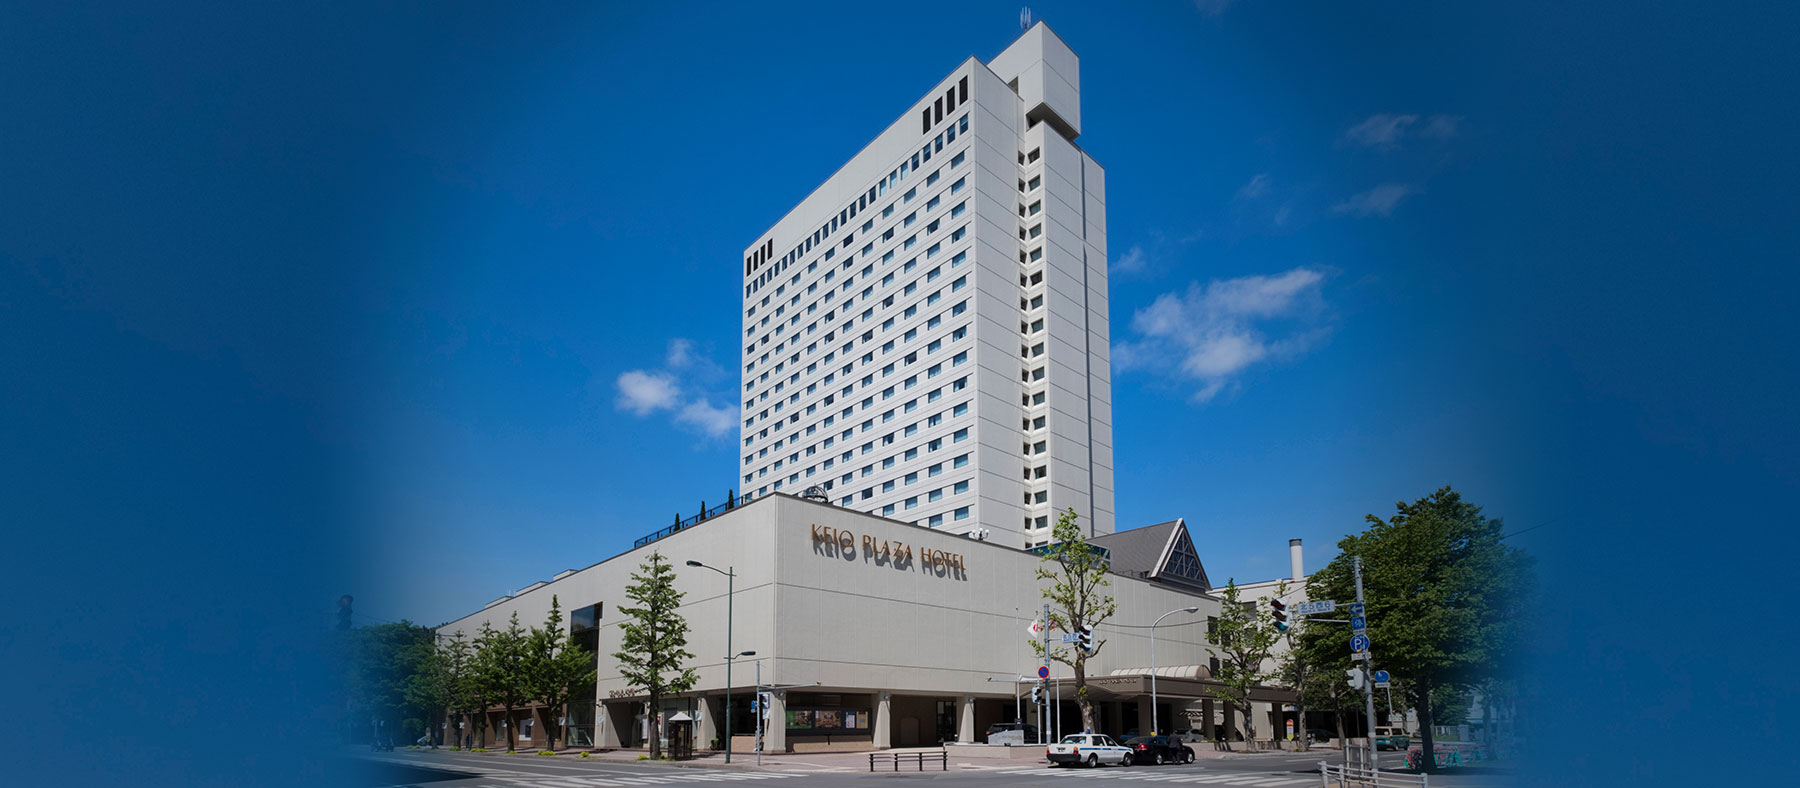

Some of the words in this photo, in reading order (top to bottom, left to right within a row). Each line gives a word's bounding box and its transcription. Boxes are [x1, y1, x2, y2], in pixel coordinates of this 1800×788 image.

[811, 523, 855, 548] KEIO
[862, 534, 914, 561] PLAZA
[920, 546, 967, 573] HOTEL
